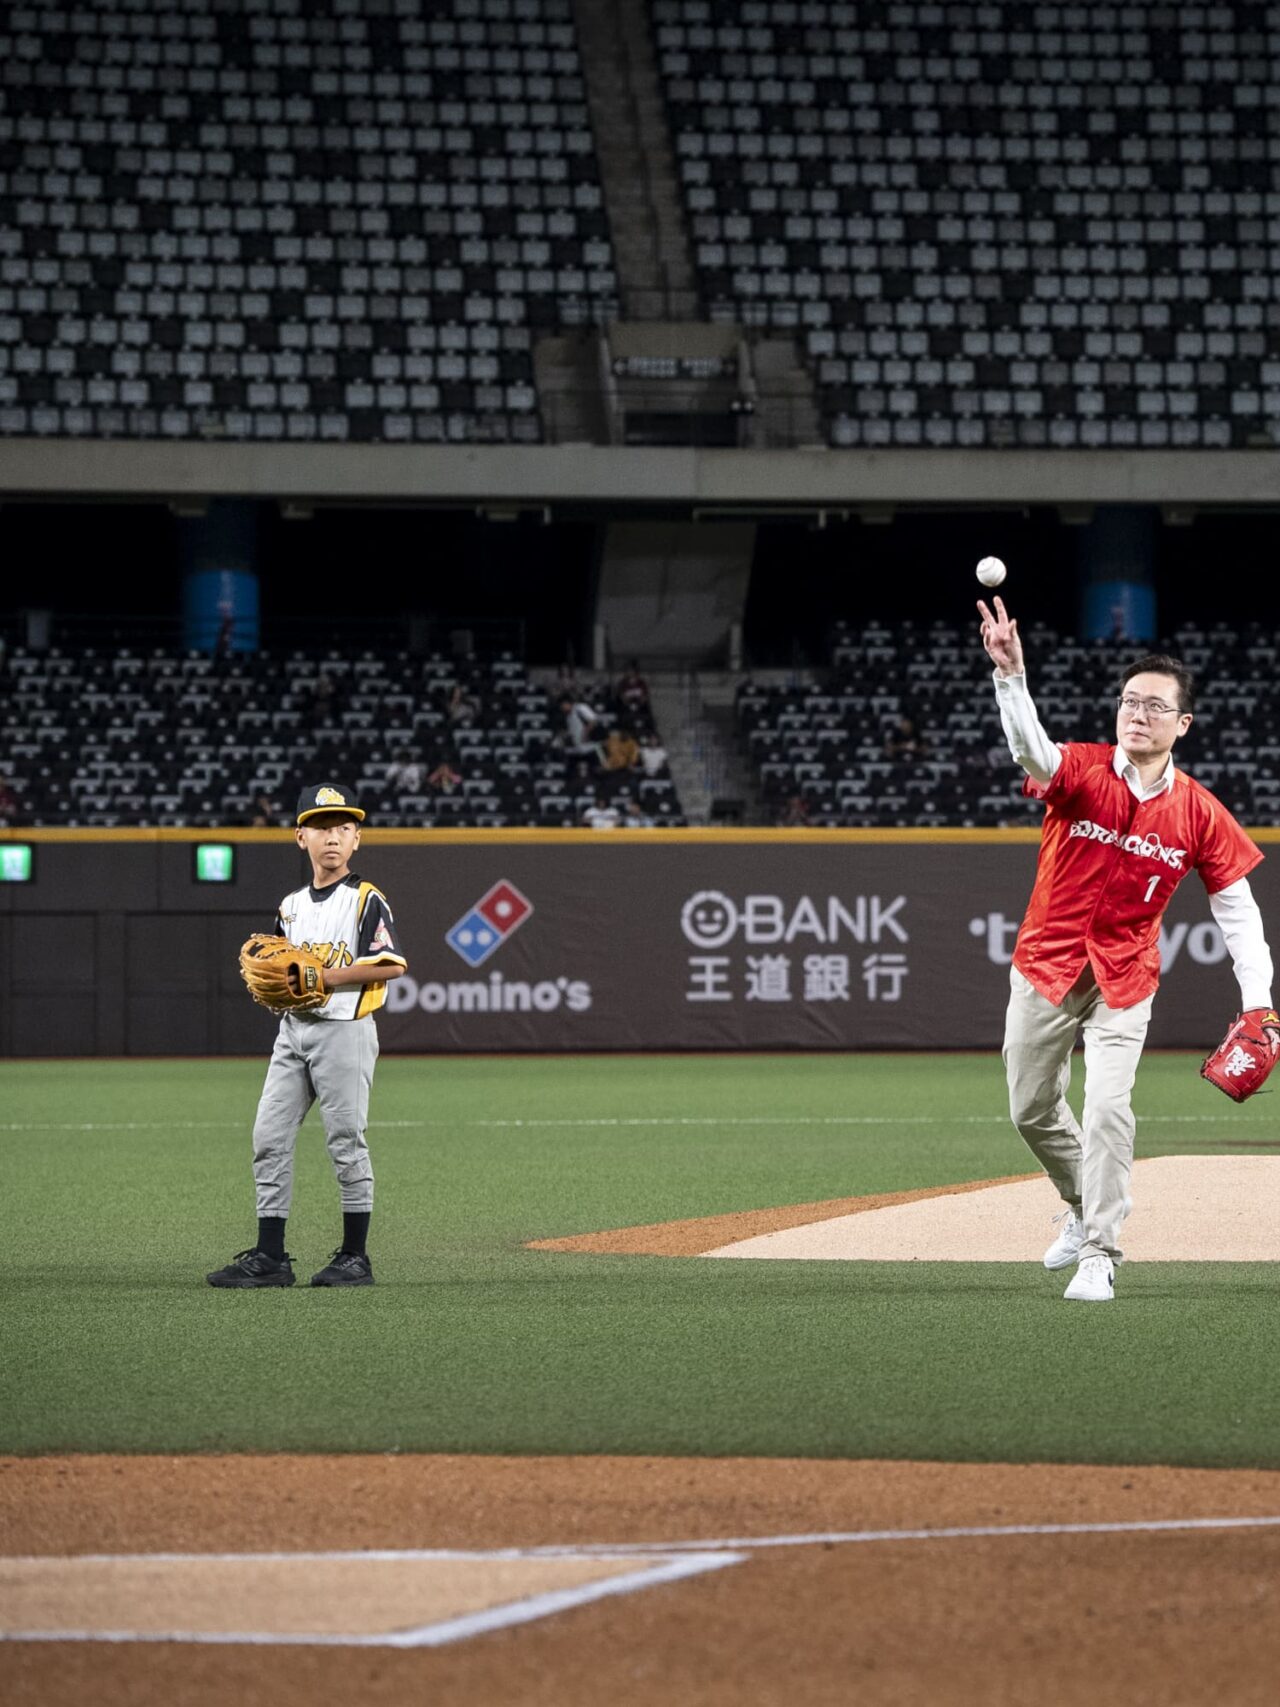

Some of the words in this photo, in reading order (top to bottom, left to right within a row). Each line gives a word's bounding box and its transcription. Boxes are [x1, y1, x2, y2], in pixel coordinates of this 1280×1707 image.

[1144, 875, 1161, 902] 1
[385, 973, 594, 1013] Domino's
[686, 955, 908, 1001] 王道銀行
